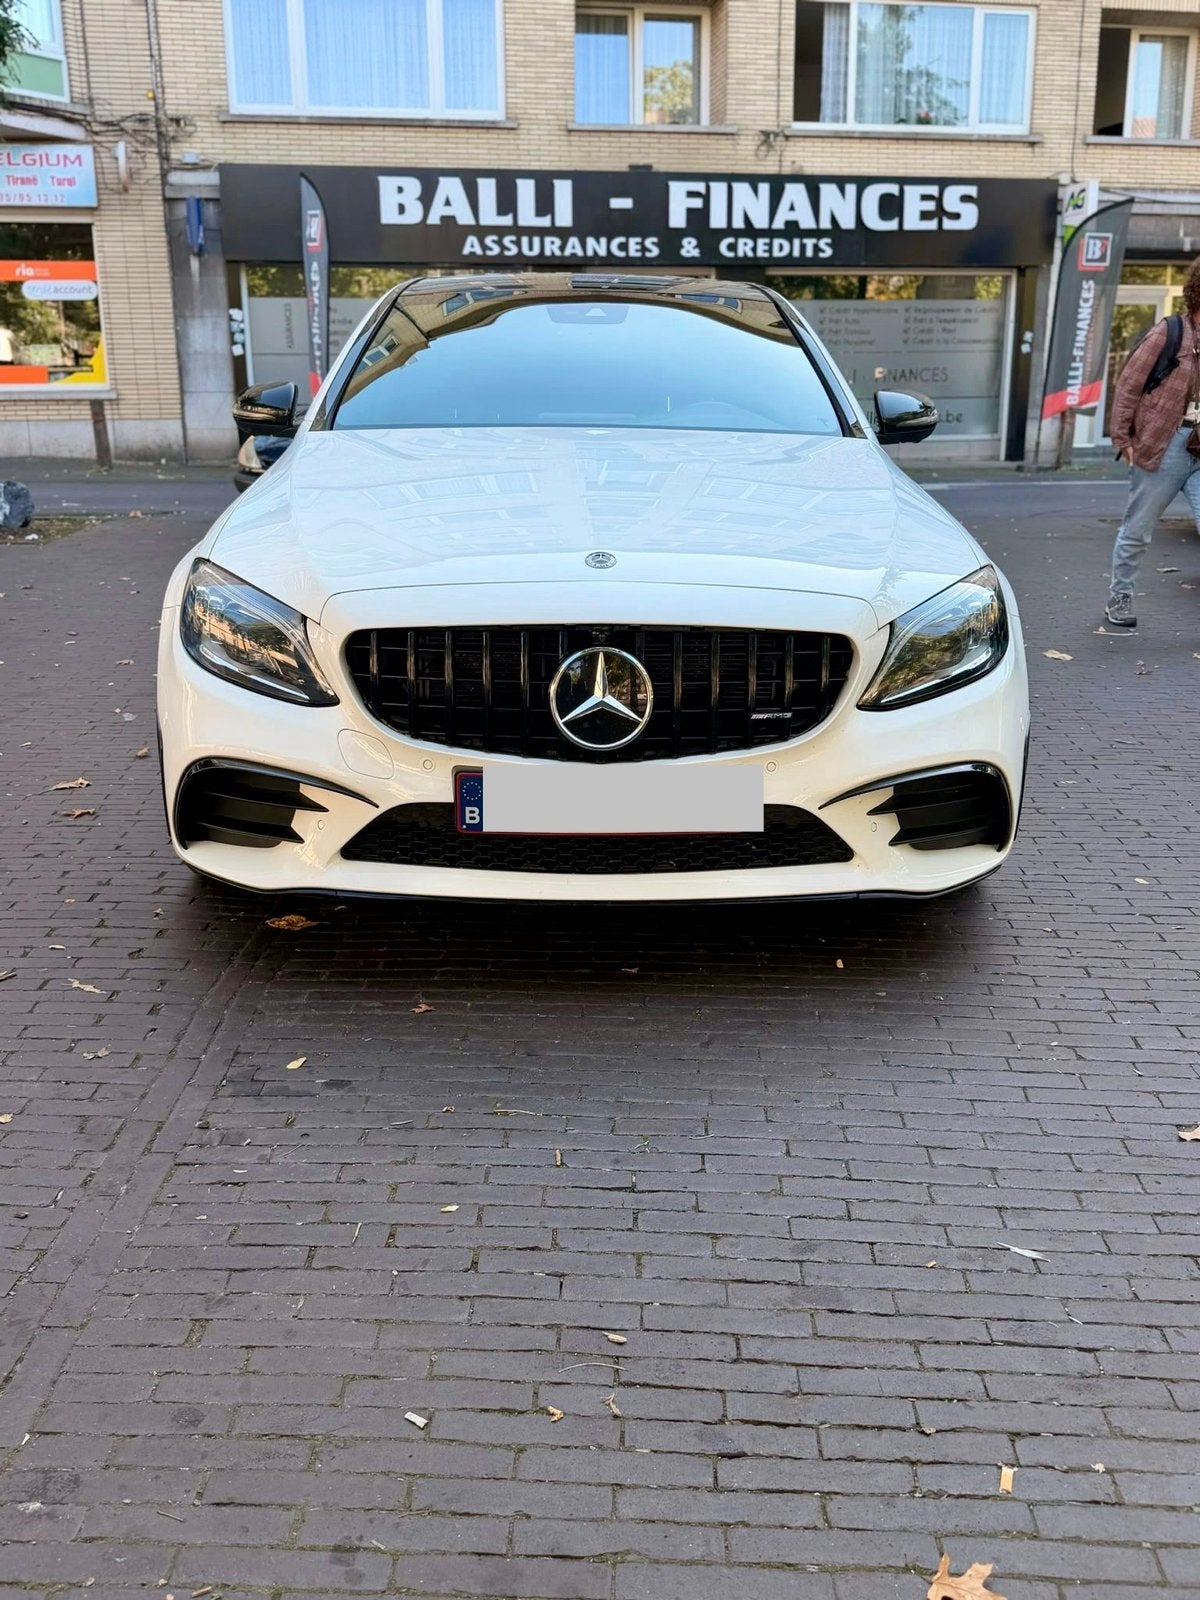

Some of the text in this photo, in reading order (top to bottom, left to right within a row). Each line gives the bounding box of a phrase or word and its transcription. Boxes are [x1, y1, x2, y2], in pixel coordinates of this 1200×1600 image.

[378, 176, 574, 227] BALLI
[667, 180, 980, 231] FINANCES
[462, 235, 834, 259] ASSURANCES & CREDITS
[15, 263, 34, 276] ria
[1065, 279, 1095, 405] BALLI-FINANCES
[874, 366, 949, 384] INANCES
[465, 806, 481, 824] B
